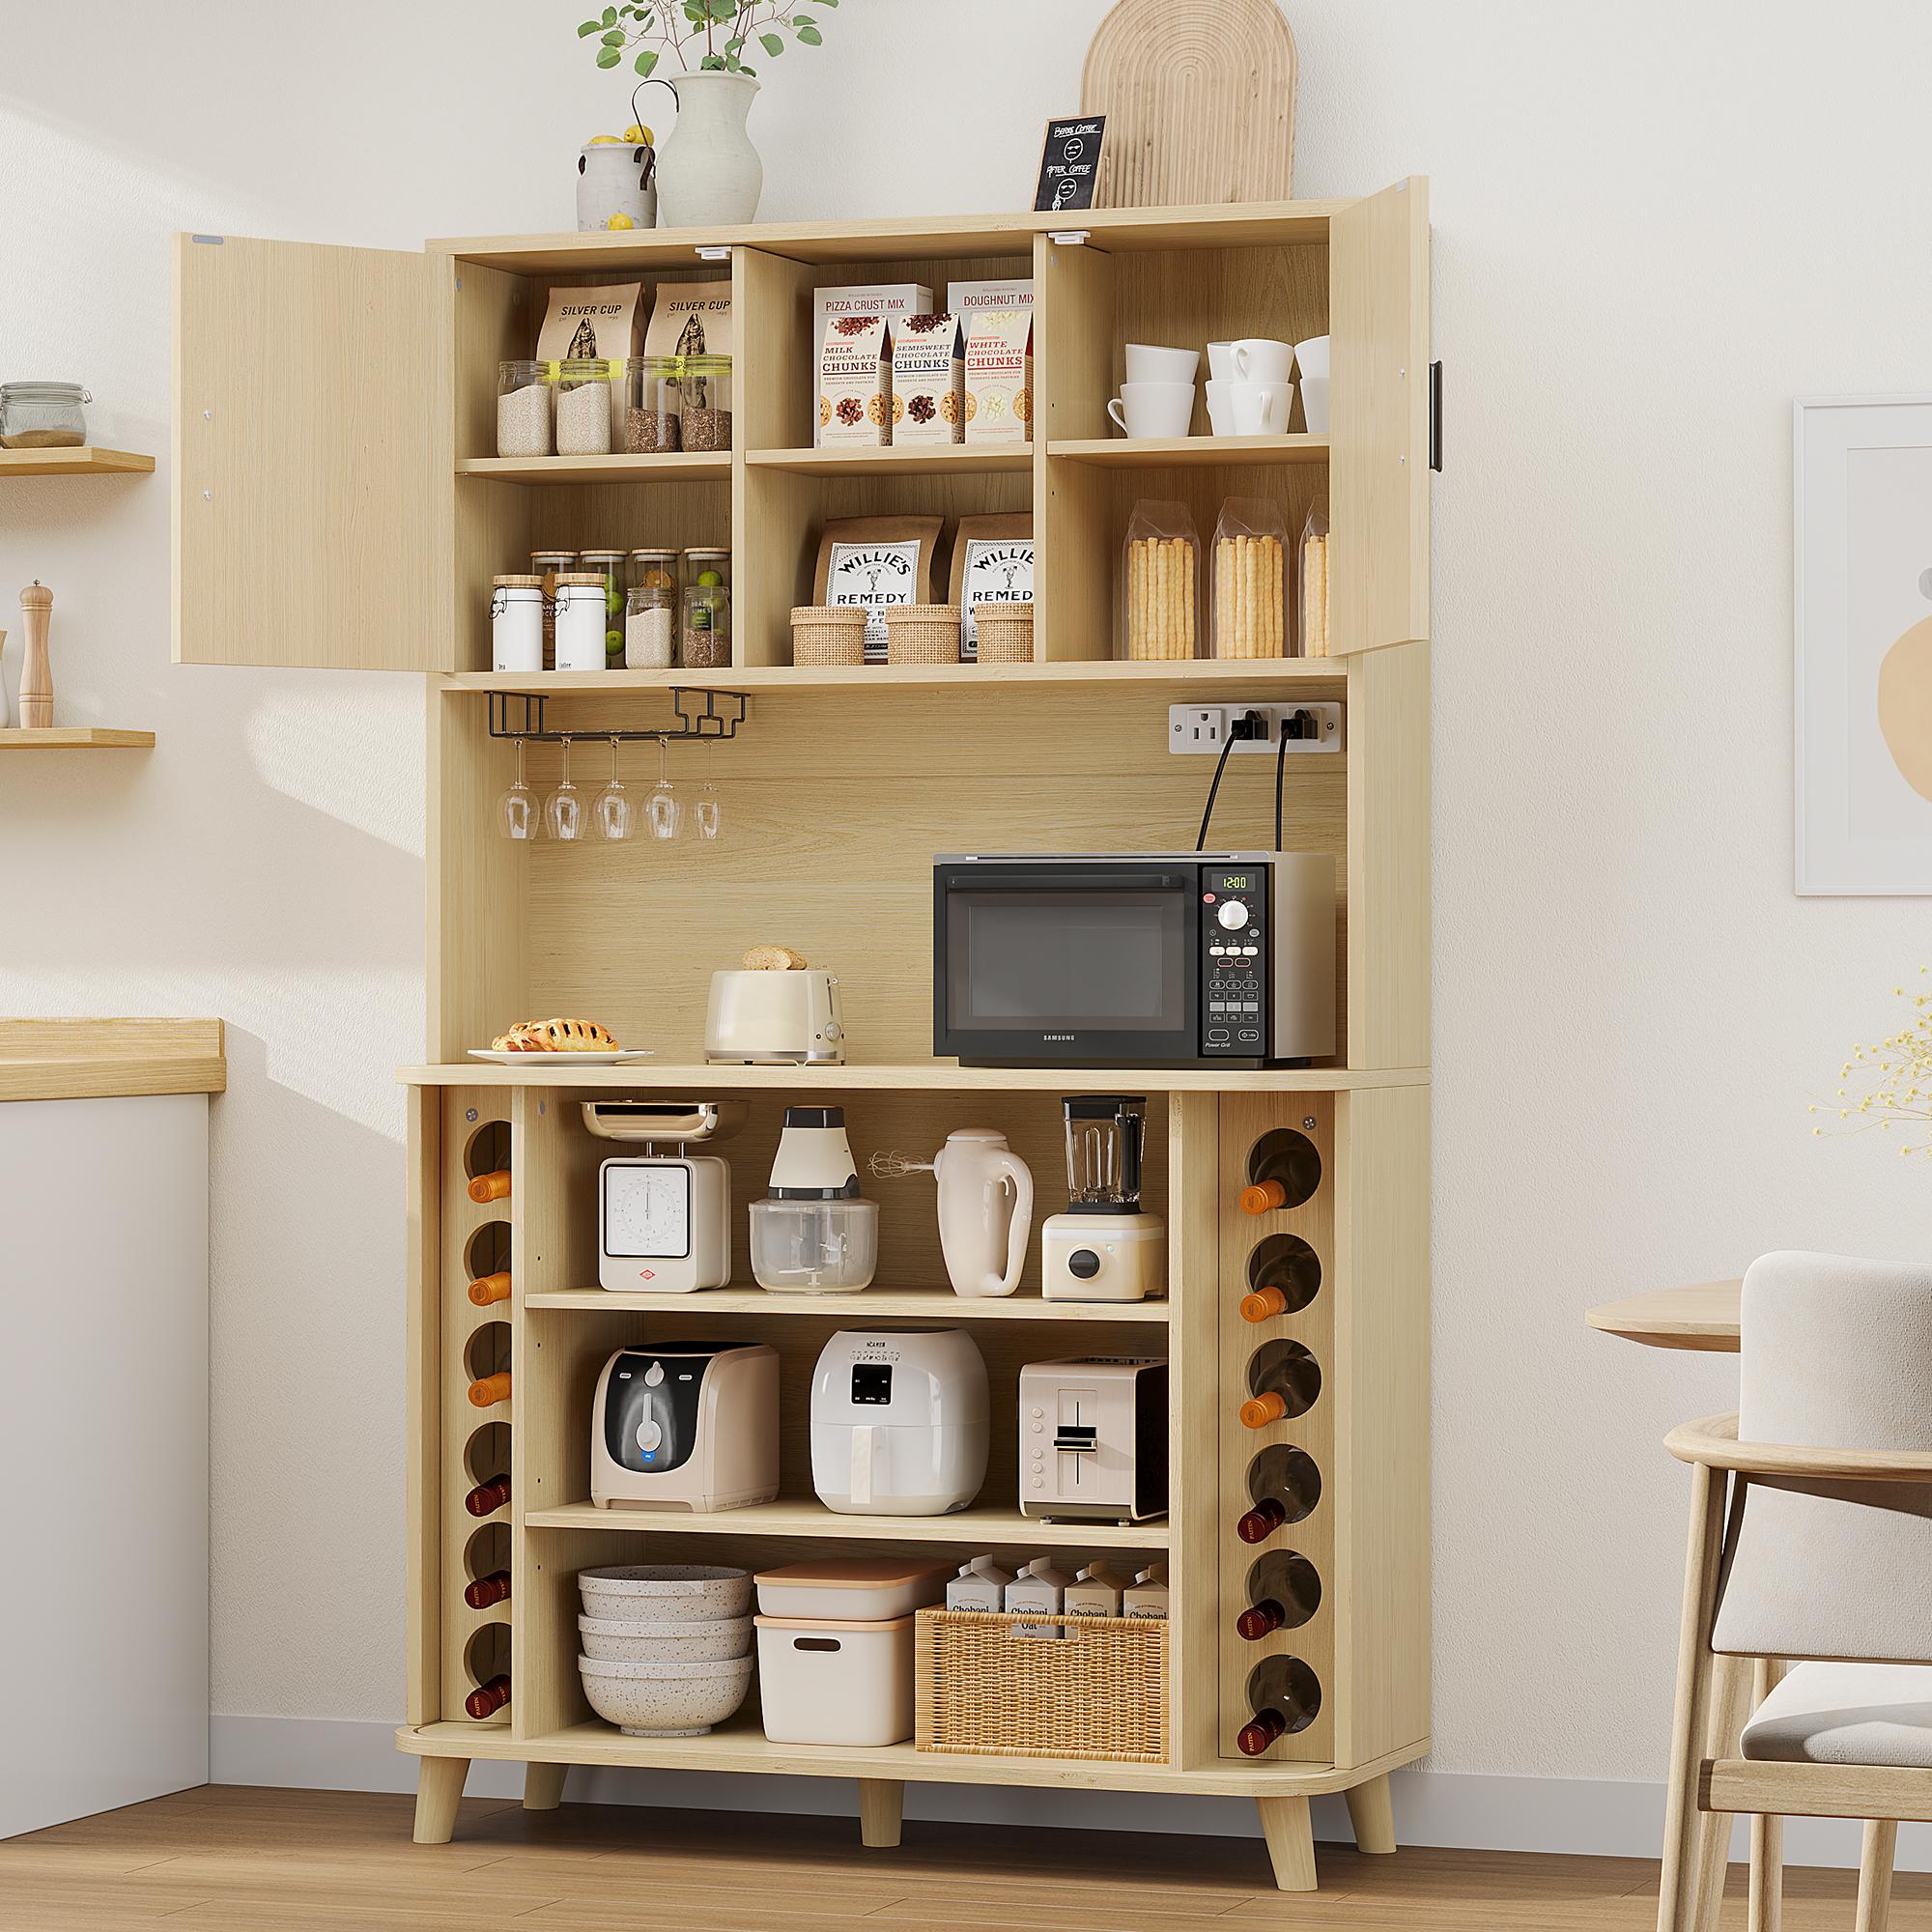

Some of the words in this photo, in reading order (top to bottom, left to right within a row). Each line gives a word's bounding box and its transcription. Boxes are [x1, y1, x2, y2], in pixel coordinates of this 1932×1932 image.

[1047, 165, 1067, 178] AFTER
[1068, 164, 1092, 174] COFFEE
[668, 301, 706, 311] SILVER
[708, 300, 731, 310] CUP
[826, 300, 852, 312] PIZZA
[854, 299, 885, 311] CRUST
[887, 298, 905, 309] MIX
[964, 295, 1015, 306] DOUGHNUT
[561, 305, 597, 316] SILVER
[600, 304, 622, 315] CUP
[822, 361, 877, 372] CHUNKS
[895, 358, 950, 369] CHUNKS
[967, 356, 1022, 367] CHUNKS
[838, 551, 911, 576] WILLIE'S
[973, 548, 1034, 571] WILLIE
[837, 593, 907, 605] REMEDY
[972, 590, 1034, 602] REMED
[1223, 877, 1246, 889] 12:00
